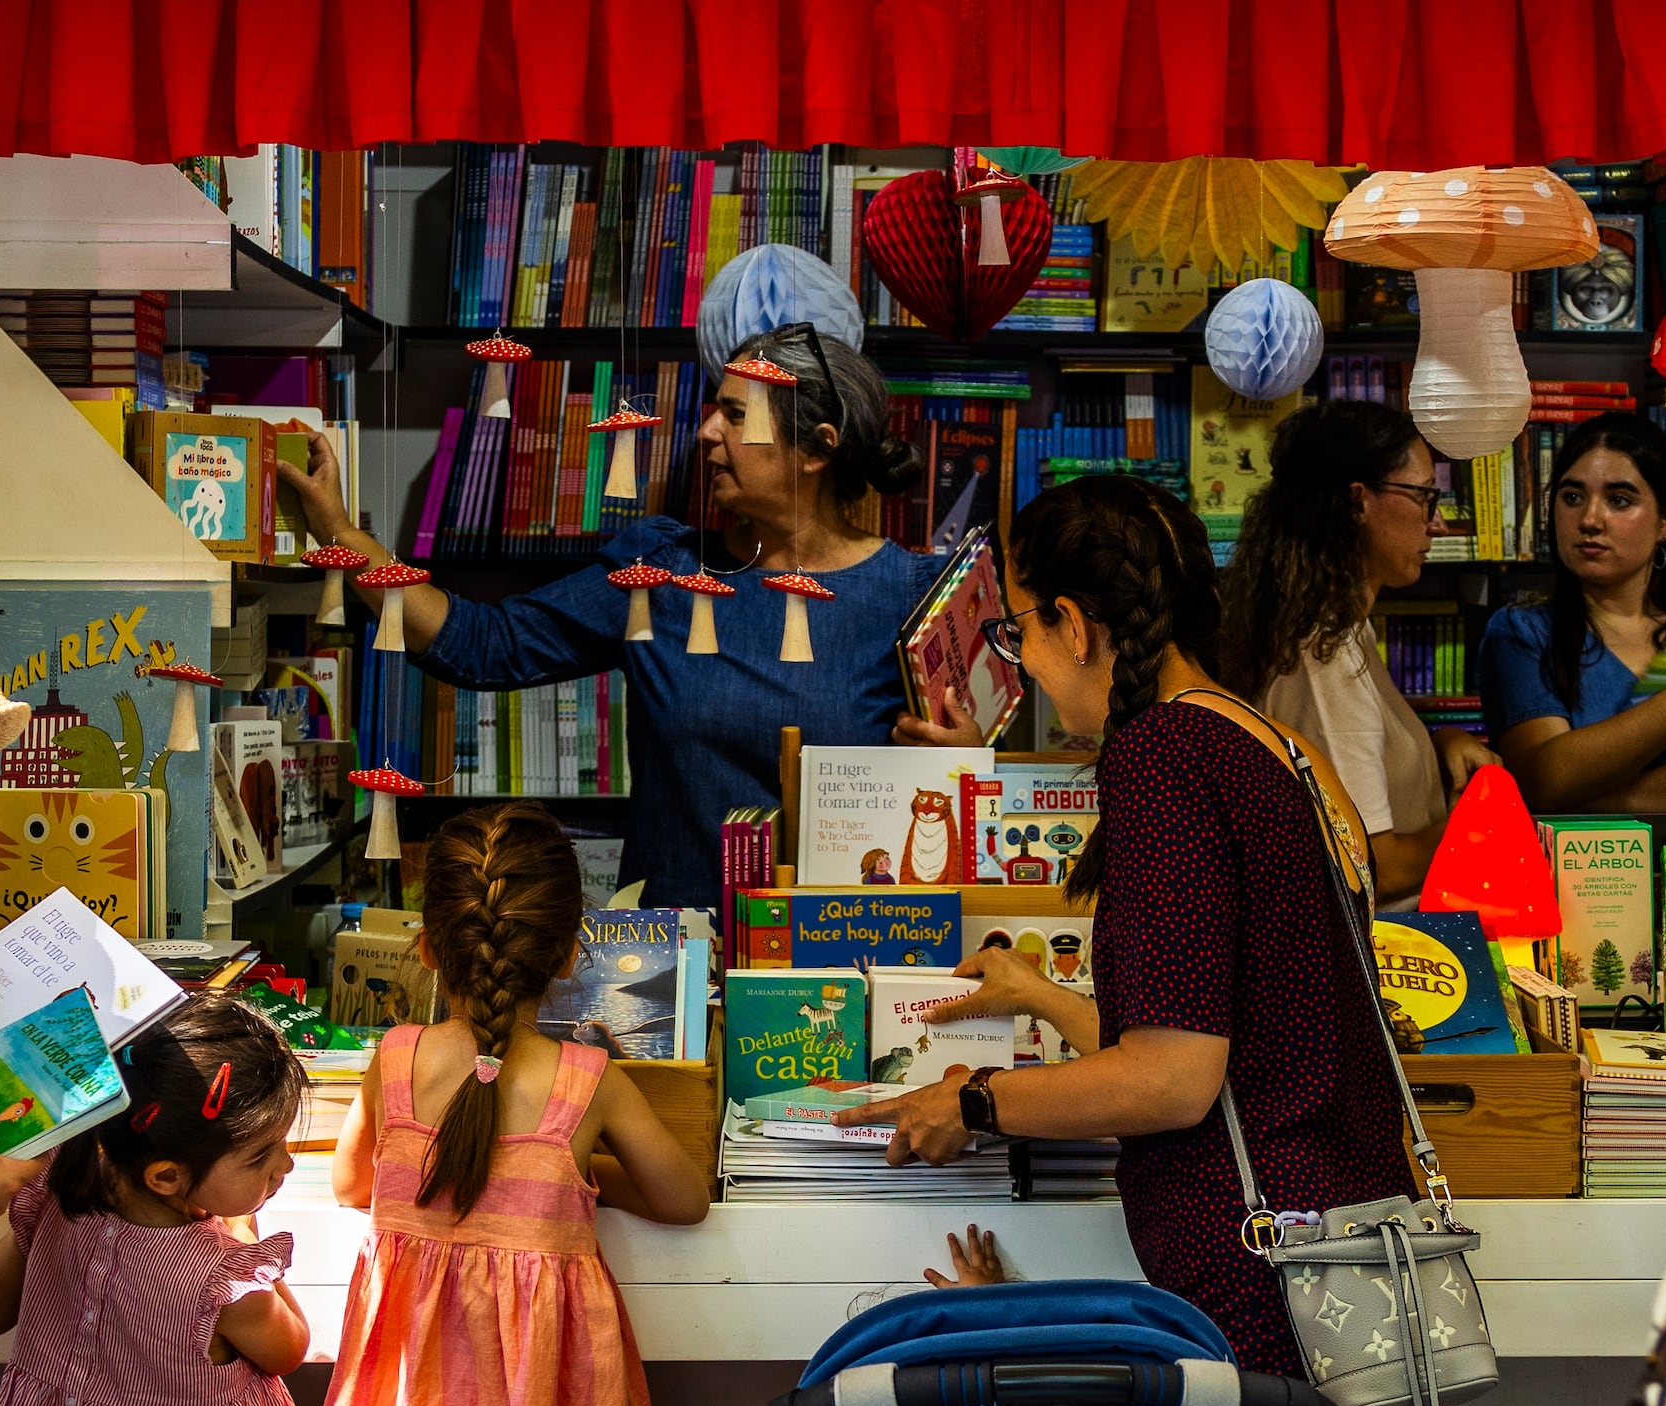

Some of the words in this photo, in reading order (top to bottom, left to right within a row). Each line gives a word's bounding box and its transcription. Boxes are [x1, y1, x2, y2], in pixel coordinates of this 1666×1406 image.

[941, 429, 995, 447] Eclipses
[183, 454, 195, 463] Mi
[197, 454, 214, 465] libro
[216, 454, 227, 464] de
[178, 467, 199, 476] baño
[201, 466, 231, 478] mágico
[59, 604, 149, 675] REX
[819, 762, 838, 777] El
[840, 762, 872, 782] tigre
[818, 781, 846, 798] que
[850, 778, 880, 794] vino
[884, 783, 895, 794] a
[1033, 780, 1042, 788] Mi
[1044, 779, 1074, 790] primer
[1076, 779, 1097, 788] libro
[818, 796, 857, 811] tomar
[861, 795, 877, 810] el
[881, 794, 897, 810] té
[818, 819, 837, 830] The
[840, 819, 866, 833] Tiger
[818, 830, 841, 841] Who
[845, 830, 874, 841] Came
[818, 842, 827, 852] to
[831, 842, 848, 852] Tea
[1563, 839, 1645, 856] AVISTA
[1563, 858, 1583, 871] EL
[1588, 855, 1645, 870] ÁRBOL
[1583, 881, 1618, 891] ÁRBOLES
[818, 902, 865, 925] ¿Qué
[869, 902, 933, 924] tiempo
[41, 909, 63, 925] El
[53, 918, 82, 945] tigre
[582, 914, 669, 945] SIRENAS
[799, 923, 845, 942] hace
[848, 923, 885, 947] hoy,
[889, 921, 952, 946] Maisy?
[22, 925, 48, 946] que
[43, 941, 68, 966] vino
[64, 962, 77, 973] a
[3, 938, 39, 967] tomar
[32, 965, 48, 980] el
[41, 973, 62, 989] té
[1379, 953, 1459, 980] LLERO
[746, 988, 787, 997] MARIANNE
[788, 988, 814, 997] DUBUC
[894, 1002, 907, 1014] El
[900, 1015, 913, 1024] de
[737, 1027, 814, 1056] Delante
[933, 1031, 975, 1041] MARIANNE
[977, 1032, 1005, 1042] DUBUC
[802, 1036, 827, 1055] de
[827, 1041, 859, 1061] mi
[39, 1037, 77, 1071] VERDE
[64, 1061, 105, 1098] COLINA
[755, 1055, 842, 1080] casa
[785, 1107, 796, 1117] EL
[798, 1107, 827, 1119] PASTEL
[841, 1128, 877, 1140] agujero!
